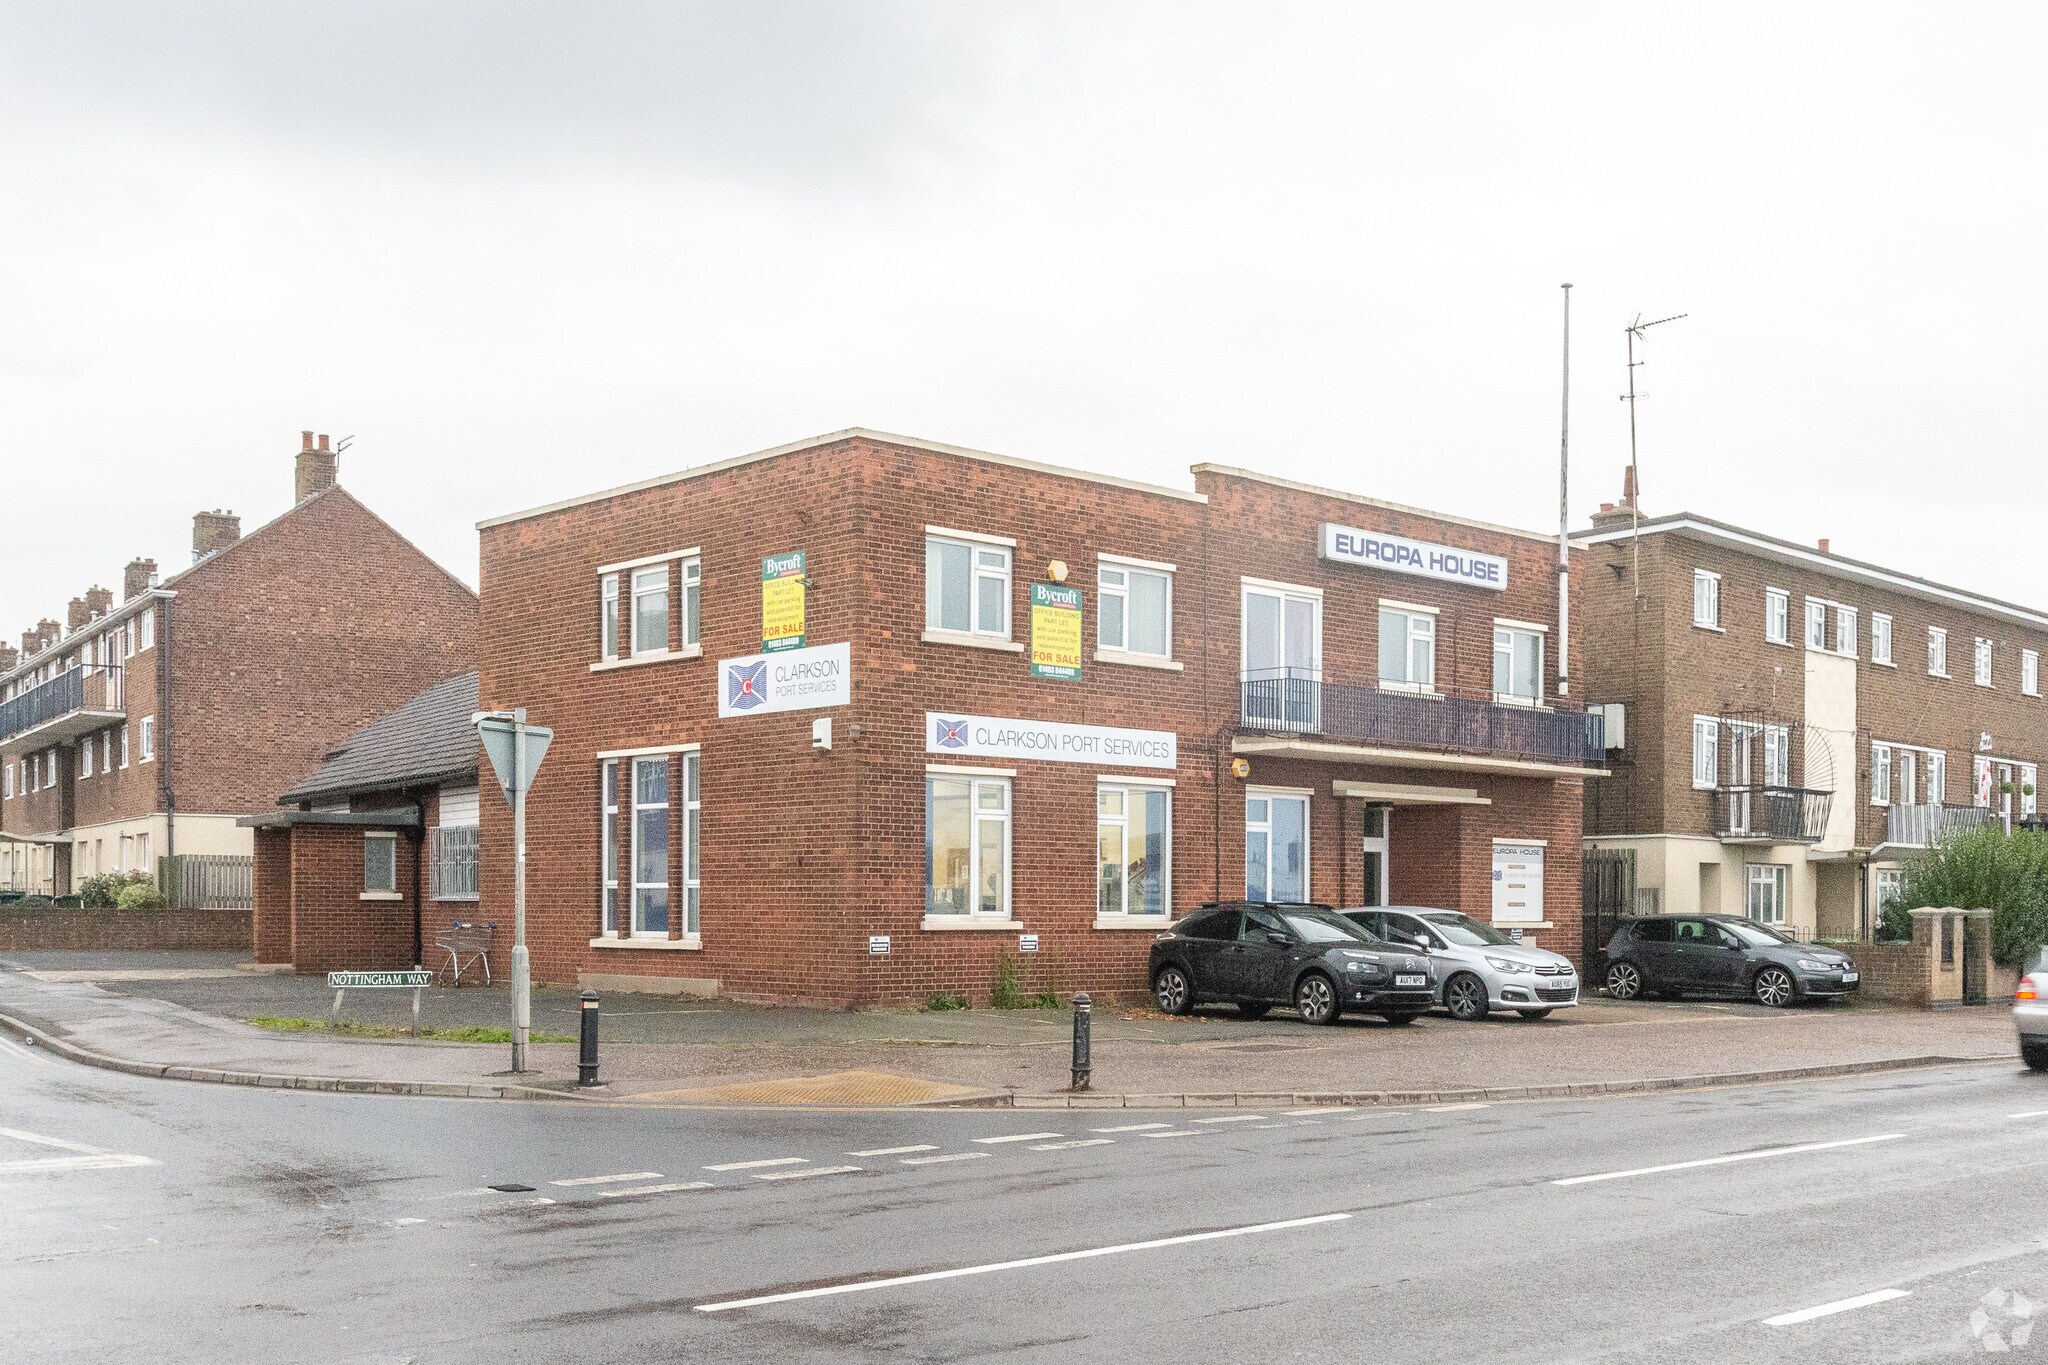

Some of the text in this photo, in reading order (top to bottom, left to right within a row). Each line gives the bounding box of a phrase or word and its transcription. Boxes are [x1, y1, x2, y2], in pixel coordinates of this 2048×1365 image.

[1335, 533, 1499, 582] EUROPA HOUSE
[767, 554, 801, 576] Bycroft
[764, 581, 780, 589] OFFICE
[785, 587, 794, 595] LET
[1037, 585, 1077, 604] Bycroft
[784, 597, 801, 605] parking
[1034, 608, 1080, 620] OFFICE BUILDING
[763, 622, 804, 637] FOR SALE
[1057, 628, 1077, 637] parking
[1047, 636, 1069, 644] potential
[1037, 642, 1075, 652] redevelopment
[1033, 651, 1080, 665] FOR SALE
[775, 659, 840, 682] CLARKSON
[743, 680, 751, 693] C
[776, 680, 837, 697] PORT SERVICES
[948, 729, 956, 739] C
[976, 728, 1170, 758] CLARKSON PORT SERVICES
[332, 974, 429, 985] NOTTINGHAM WAY
